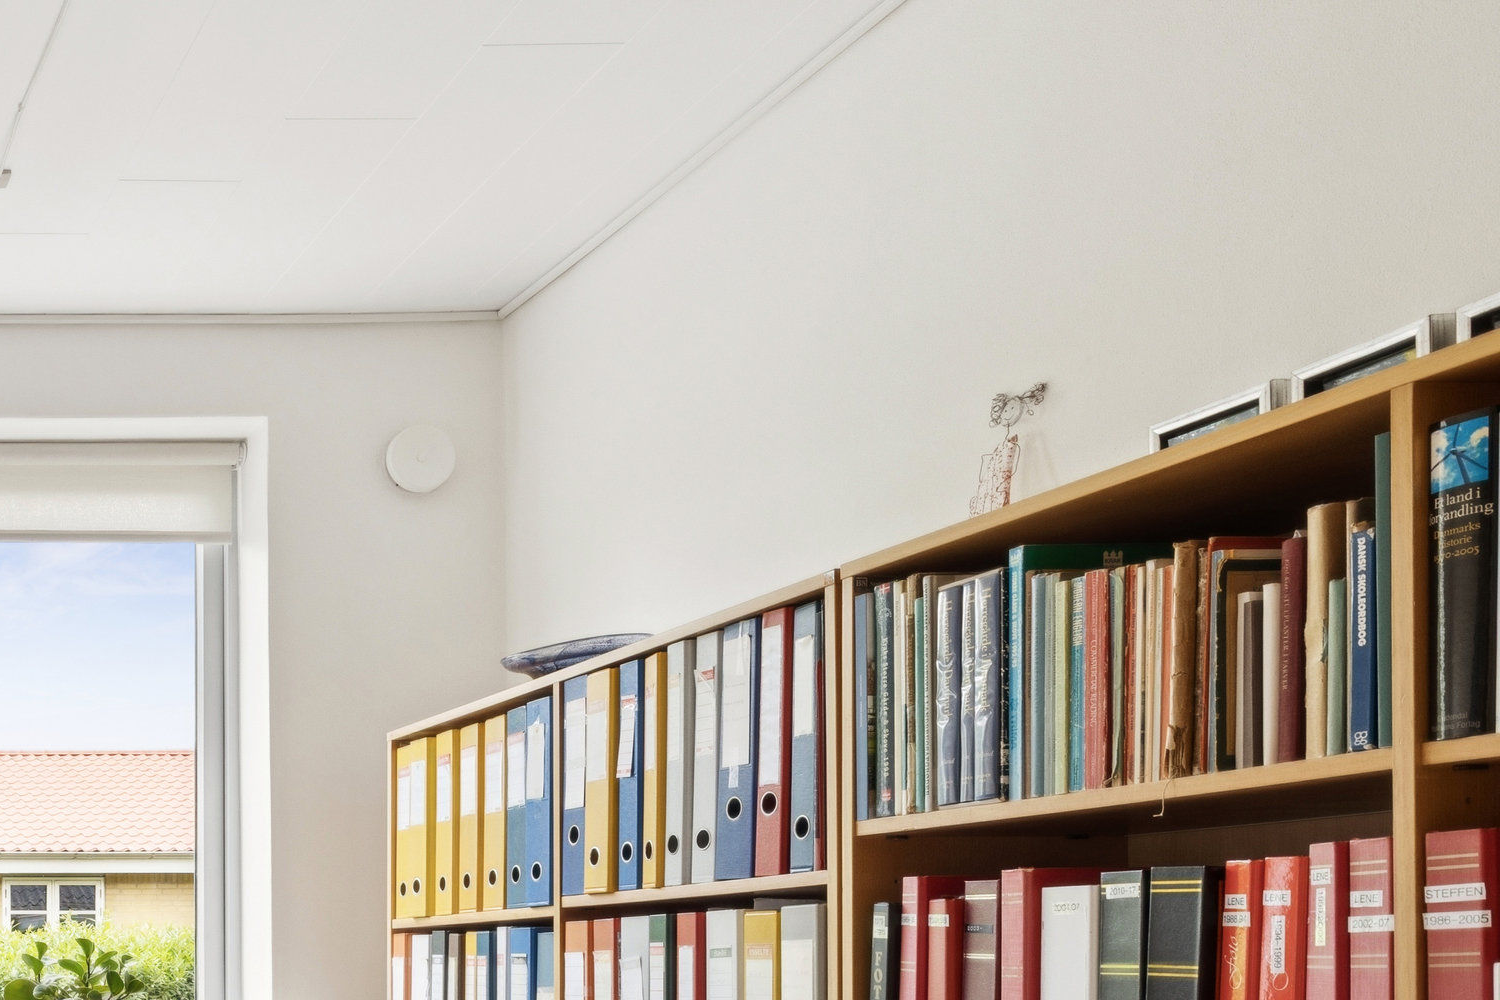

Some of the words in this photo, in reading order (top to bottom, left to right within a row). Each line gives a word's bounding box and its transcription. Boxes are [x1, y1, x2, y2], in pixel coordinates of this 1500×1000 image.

[1446, 487, 1473, 506] land
[1477, 486, 1481, 499] i
[1434, 521, 1481, 539] Dnmarks
[1437, 534, 1473, 548] istorie
[1357, 537, 1366, 572] DANSK
[1434, 545, 1480, 563] 190-2005
[1073, 582, 1084, 613] MODERN
[1357, 574, 1367, 647] SKOLEORDBOG
[1072, 615, 1083, 647] ENGLISH
[882, 691, 890, 715] Gårde
[1312, 872, 1329, 881] LENE
[1264, 893, 1288, 903] LENE
[1354, 893, 1379, 904] LENE
[1425, 886, 1484, 900] STEFFEN
[1227, 897, 1245, 906] LENE
[1352, 918, 1390, 929] 2002-07
[1424, 913, 1490, 926] 1986-2005
